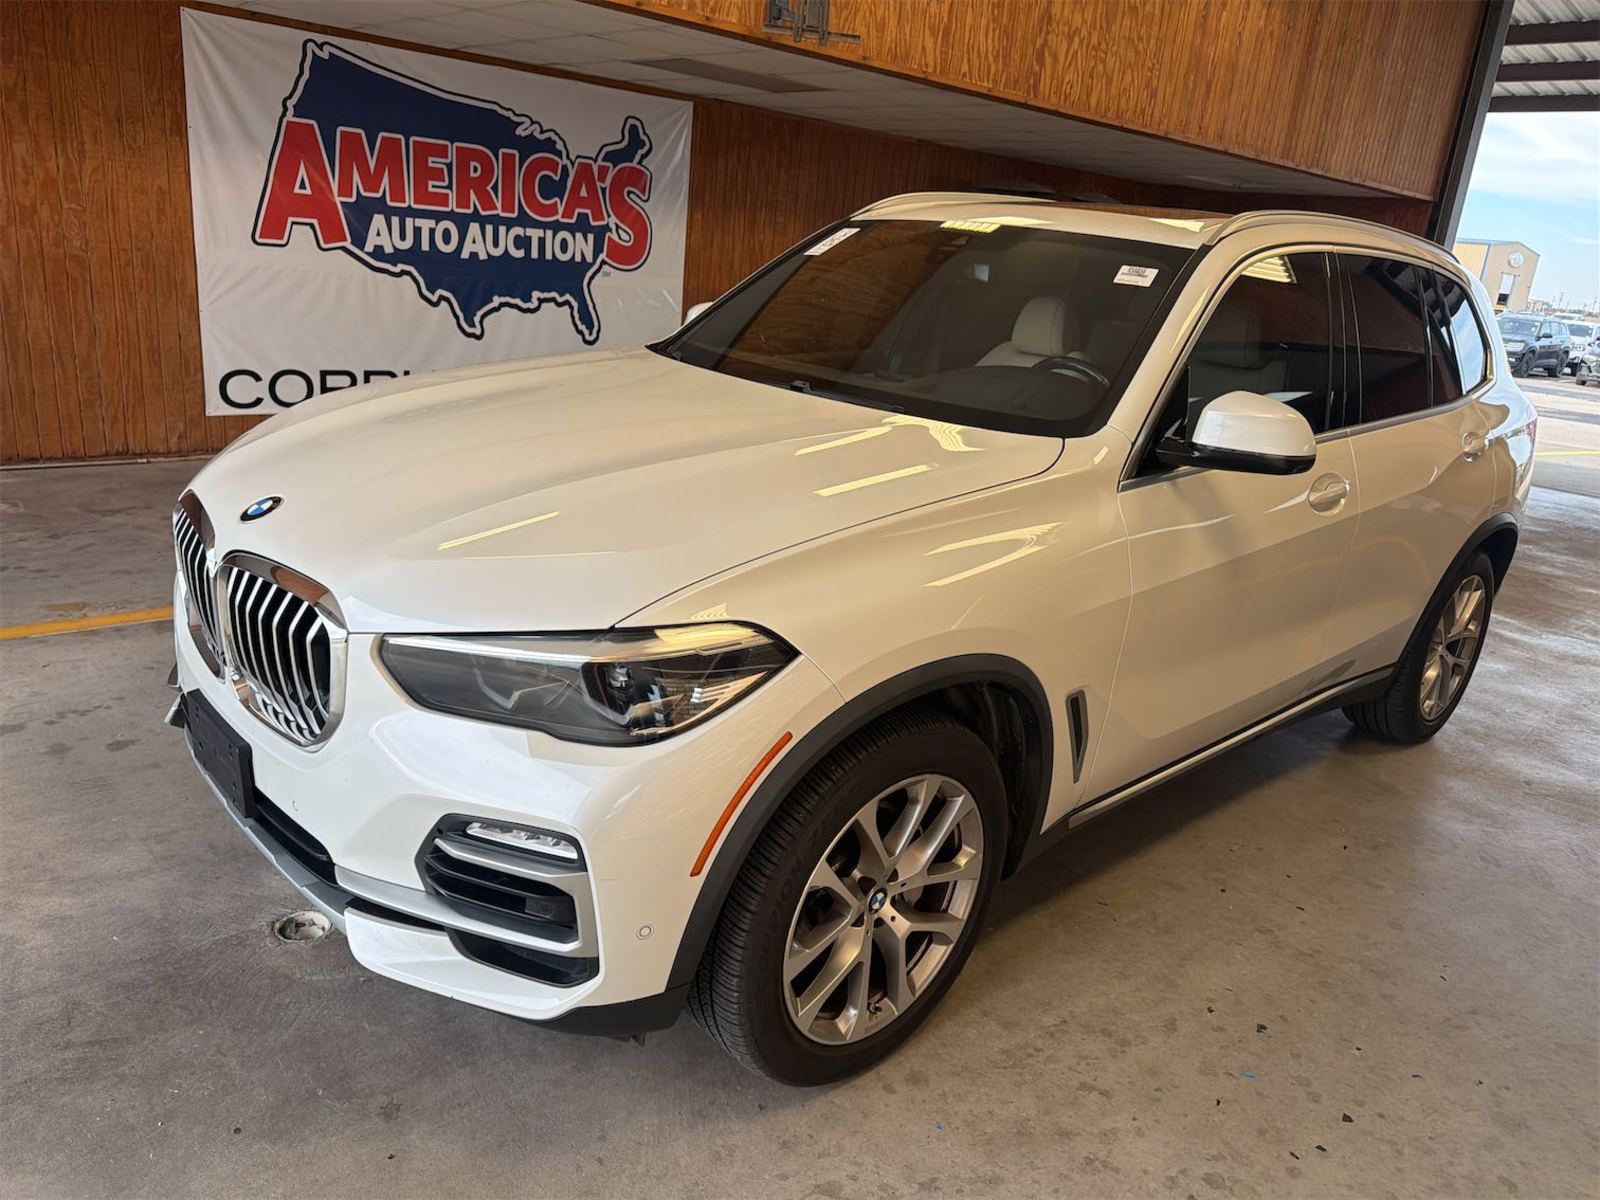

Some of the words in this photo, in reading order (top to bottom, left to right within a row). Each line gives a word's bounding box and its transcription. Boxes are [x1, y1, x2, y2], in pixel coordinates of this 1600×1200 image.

[254, 118, 652, 269] AMERICA'S
[364, 213, 459, 255] AUTO
[460, 224, 595, 264] AUCTION
